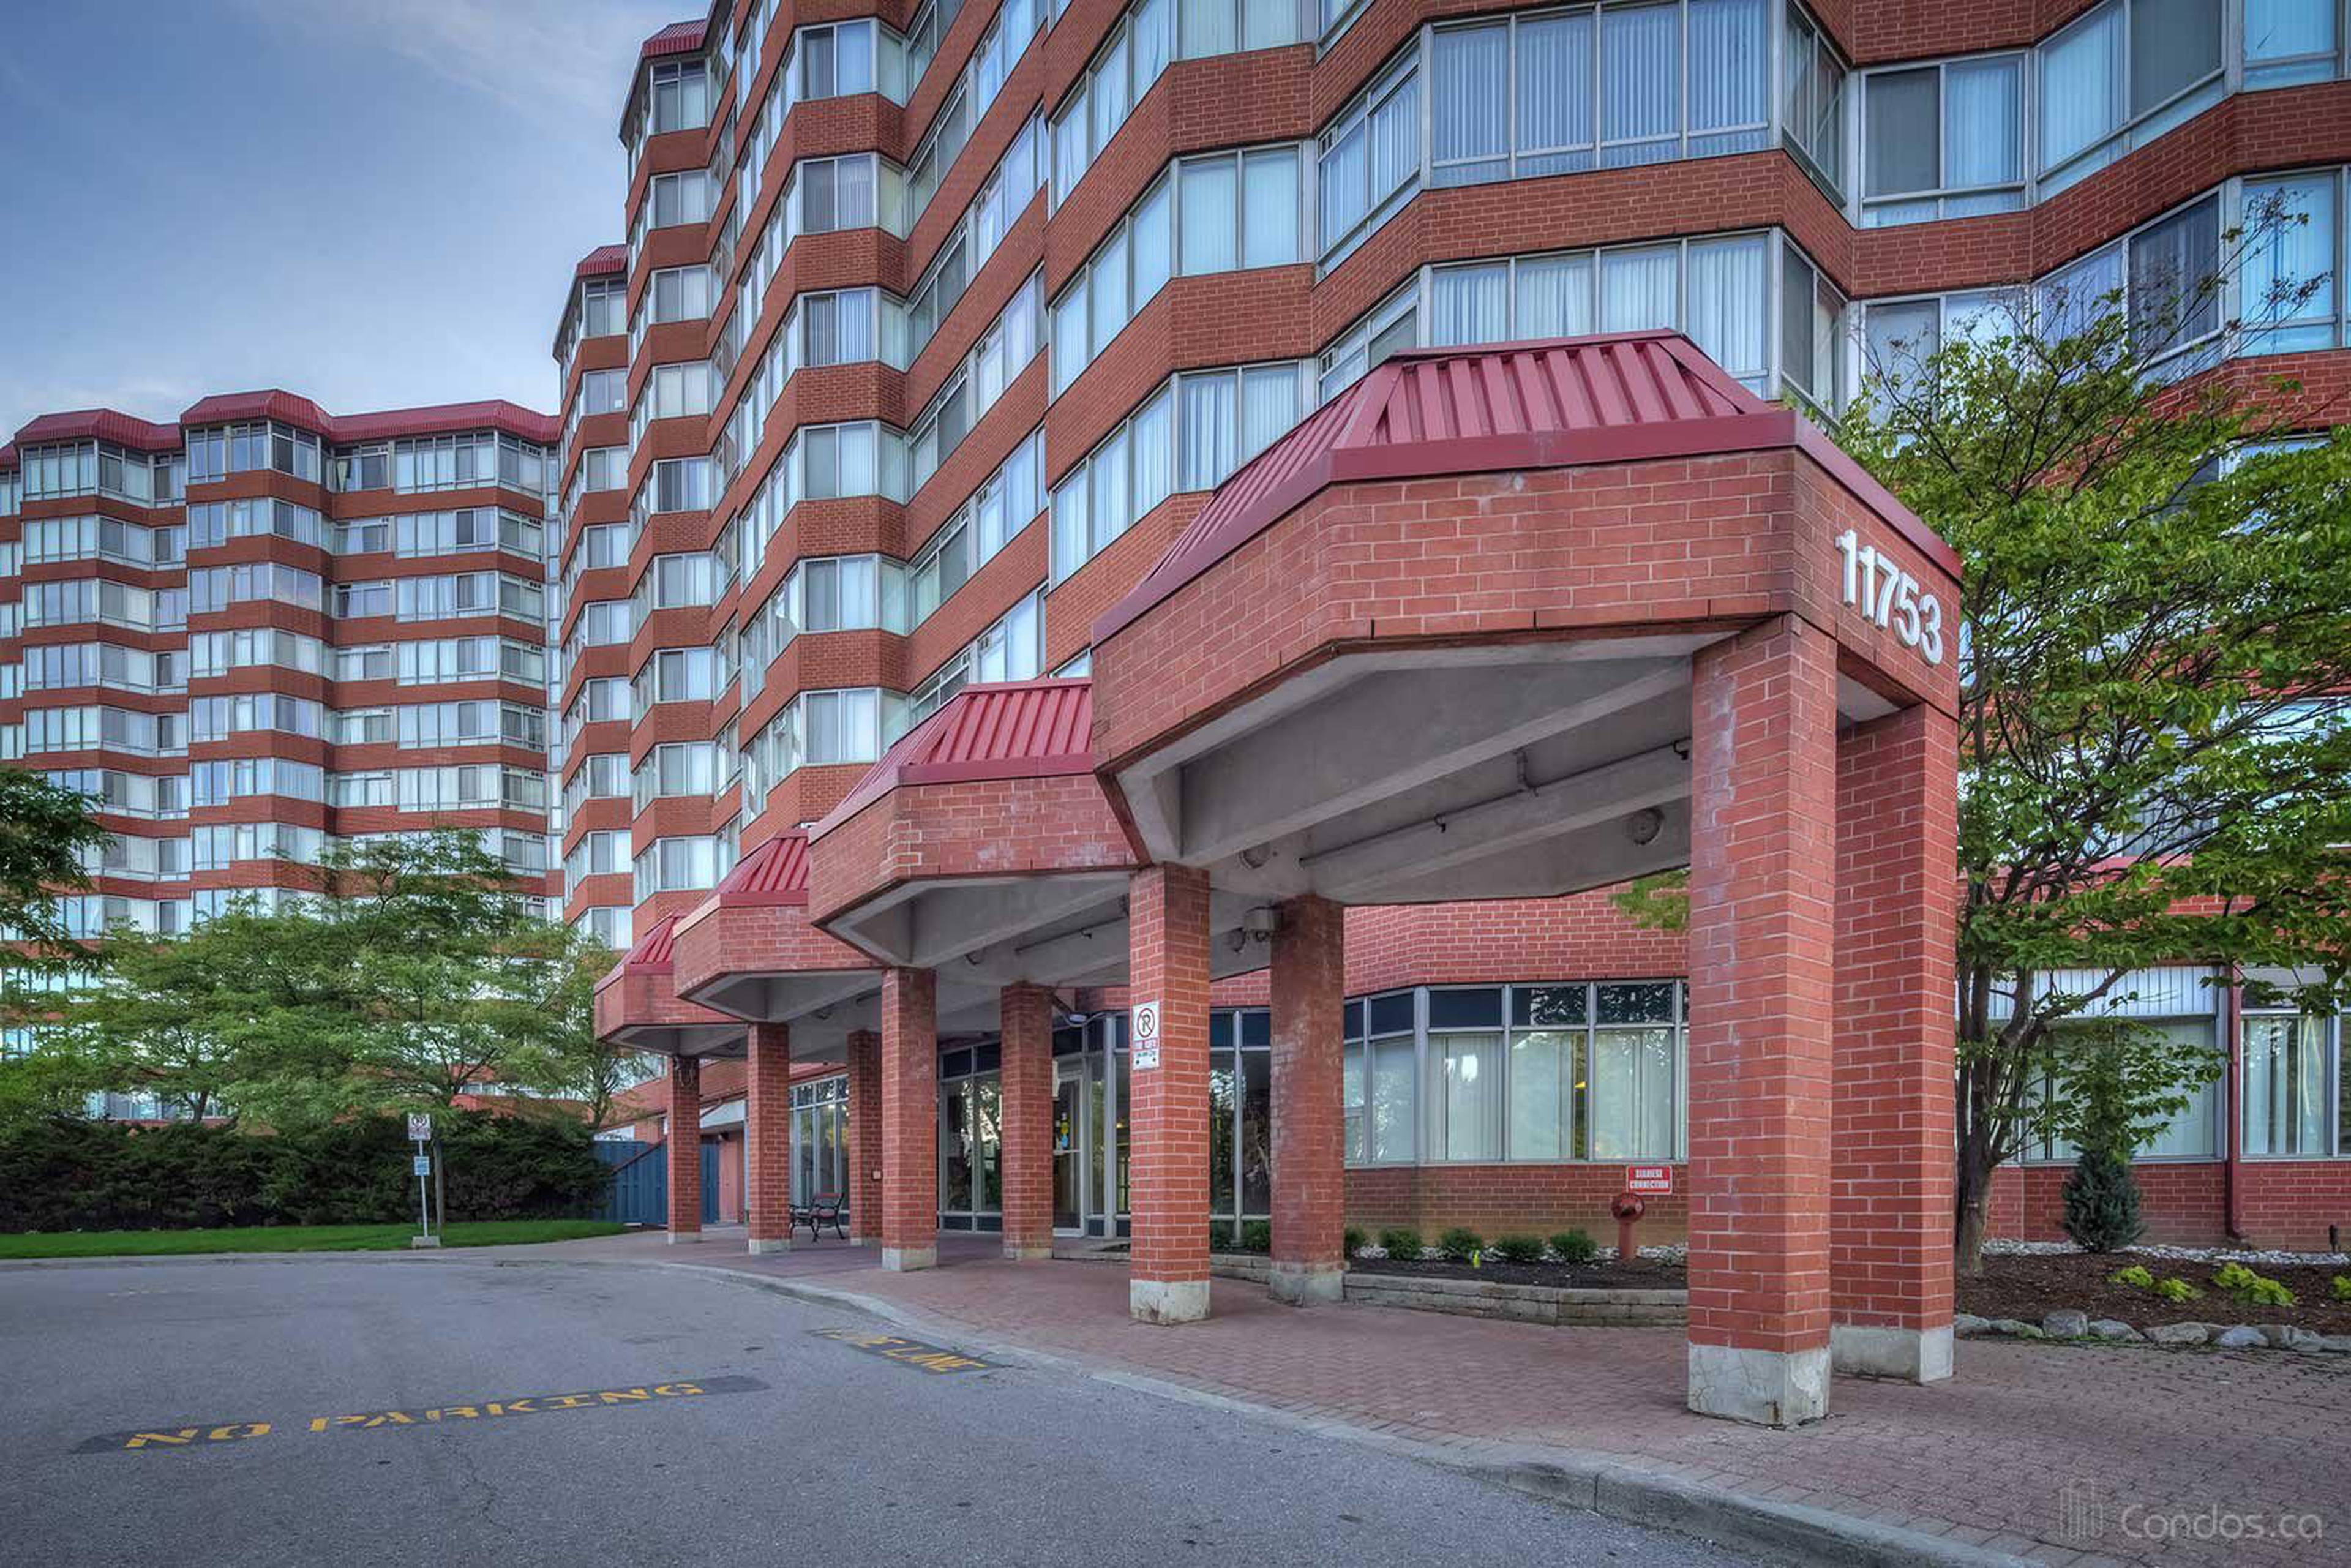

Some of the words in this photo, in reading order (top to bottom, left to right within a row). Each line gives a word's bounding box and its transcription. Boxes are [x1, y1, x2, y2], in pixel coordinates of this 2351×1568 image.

[1834, 529, 1943, 667] 11753
[124, 1423, 271, 1448] NO
[309, 1382, 705, 1432] PARKING
